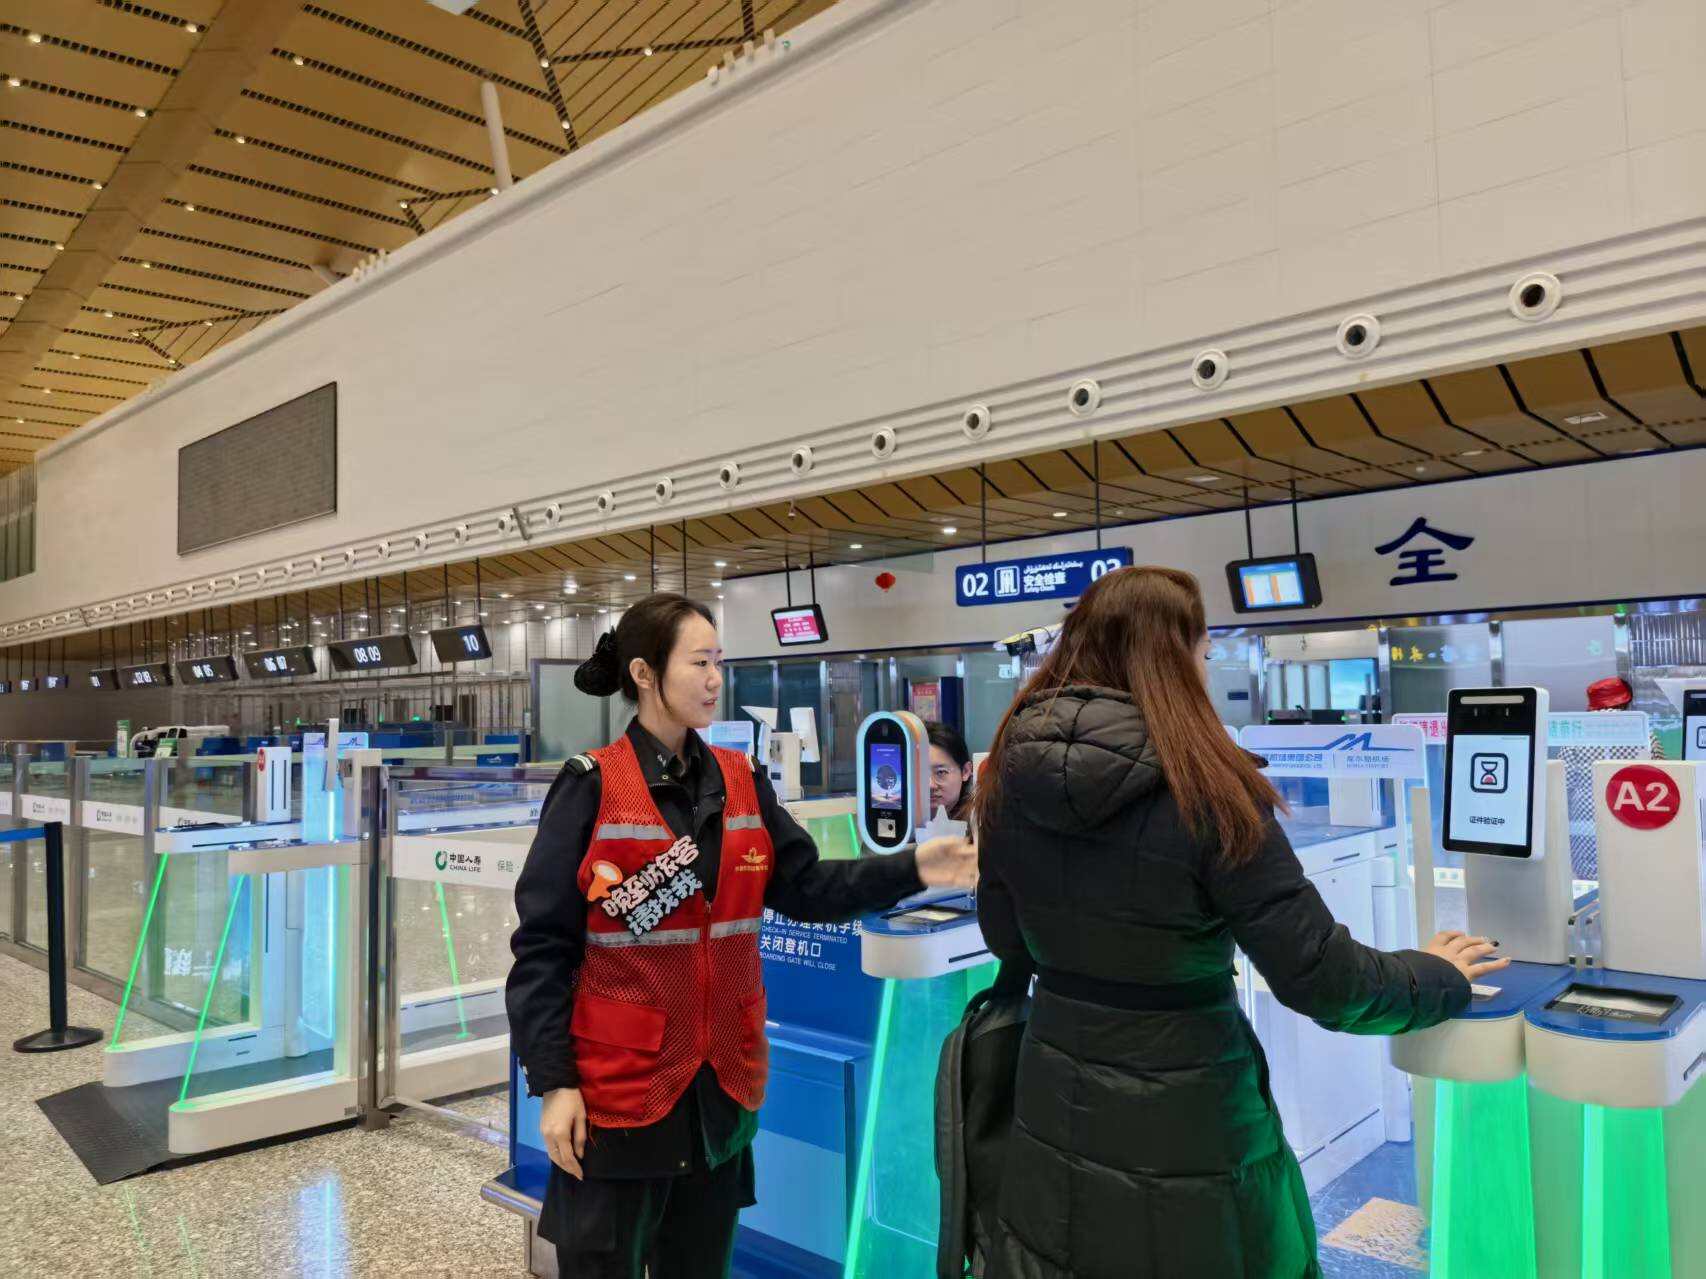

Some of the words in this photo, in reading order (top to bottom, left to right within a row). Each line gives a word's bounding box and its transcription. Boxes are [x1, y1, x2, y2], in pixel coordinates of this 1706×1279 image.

[1374, 517, 1474, 586] 全
[962, 572, 989, 597] 02
[1024, 572, 1066, 586] 安全检查
[463, 634, 480, 652] 10
[353, 647, 368, 663] 08
[368, 646, 381, 661] 09
[1613, 781, 1671, 812] A2
[449, 853, 481, 865] 中国人寿
[625, 868, 703, 936] 请找我
[761, 925, 787, 935] CHECK-IN
[788, 929, 810, 938] SERVICE
[813, 932, 848, 944] TERMINATED
[760, 934, 822, 957] 关闭登机口
[787, 956, 801, 965] GATE
[803, 959, 815, 968] WILL
[817, 961, 837, 971] CLOSE
